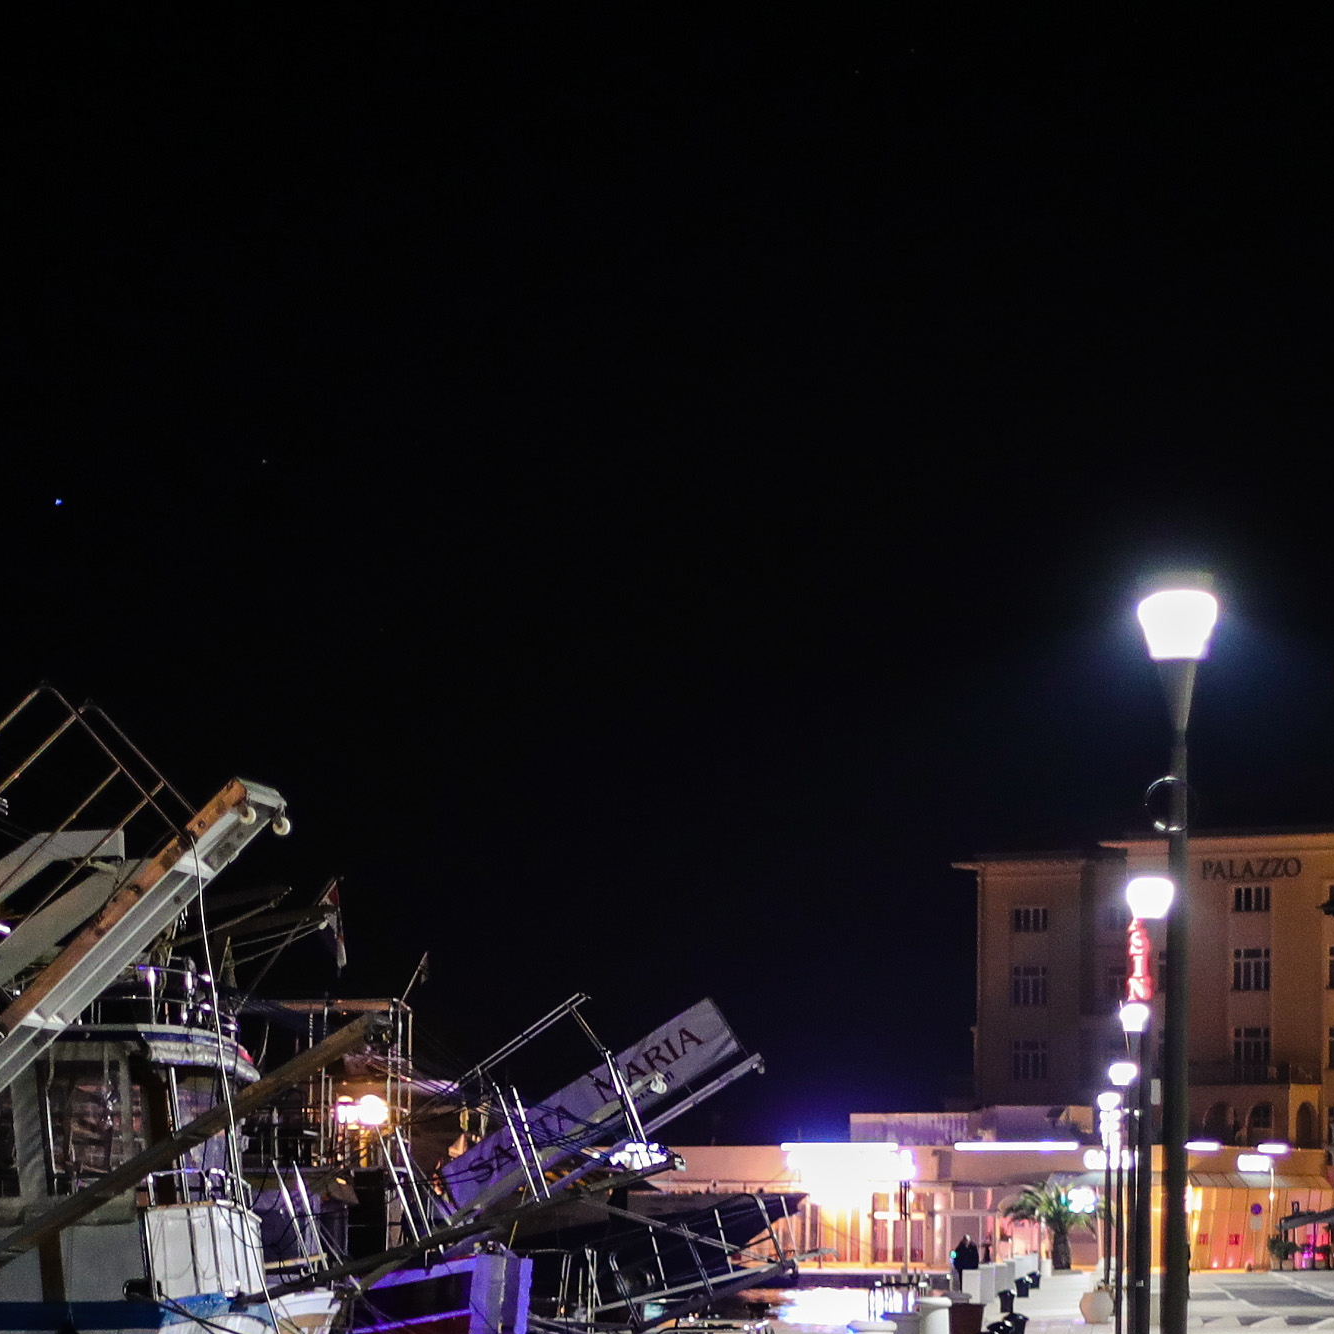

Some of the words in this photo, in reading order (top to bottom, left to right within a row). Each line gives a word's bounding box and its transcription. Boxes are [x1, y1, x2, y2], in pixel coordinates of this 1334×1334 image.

[1200, 856, 1303, 880] PALAZZO
[1126, 914, 1146, 1002] ASIN
[592, 1026, 704, 1104] MARIA
